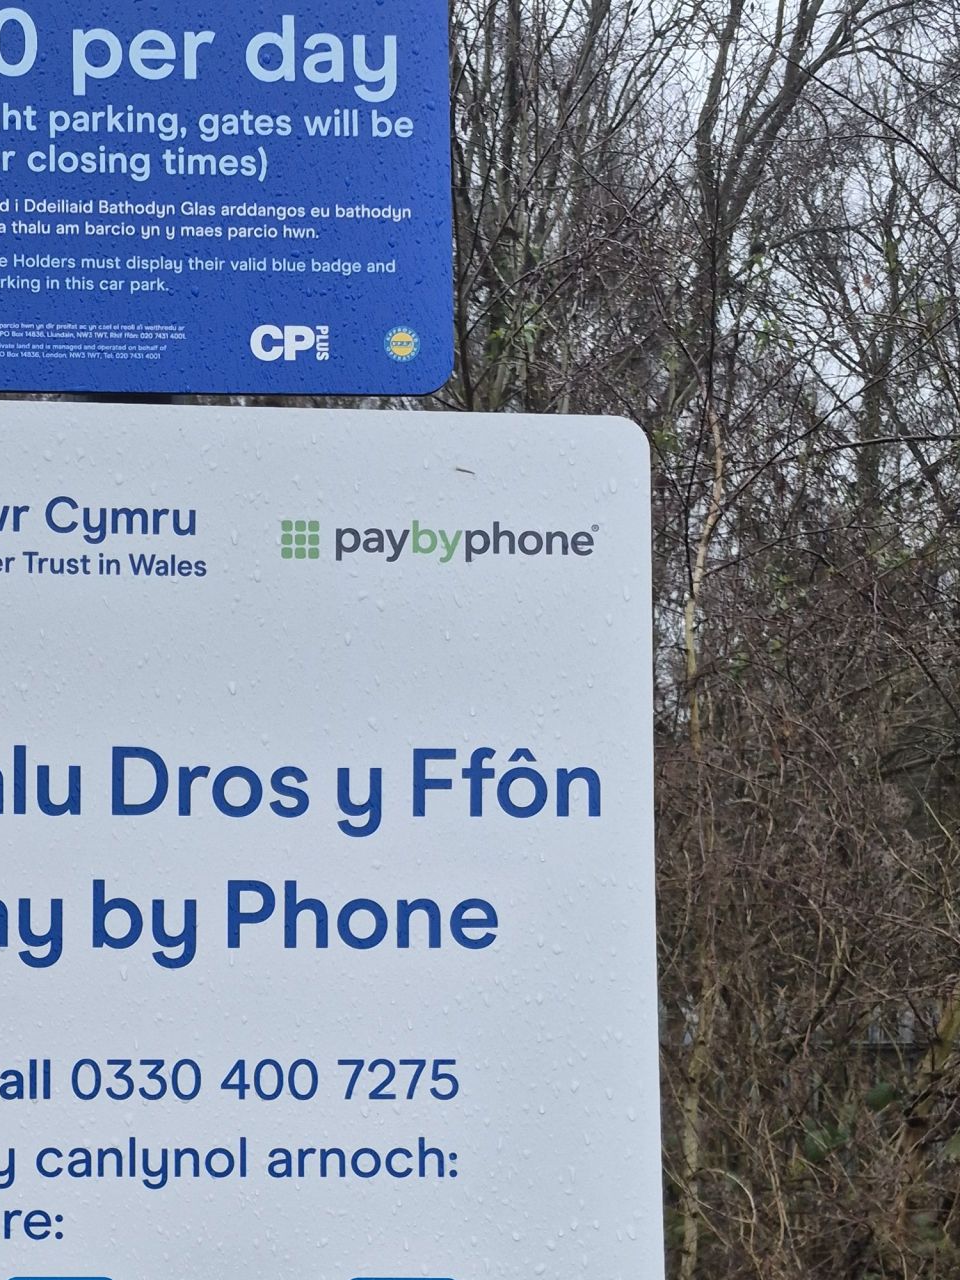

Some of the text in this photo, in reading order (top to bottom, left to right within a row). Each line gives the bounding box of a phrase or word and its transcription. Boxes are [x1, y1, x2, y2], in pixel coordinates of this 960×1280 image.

[73, 29, 215, 95] per
[246, 15, 397, 102] day
[50, 105, 186, 141] parking,
[199, 110, 291, 141] gates
[304, 109, 358, 136] will
[372, 110, 413, 137] be
[28, 144, 150, 181] closing
[163, 147, 267, 181] times)
[15, 202, 19, 211] i
[25, 199, 92, 213] Ddeiliaid
[99, 200, 175, 218] Bathodyn
[181, 202, 215, 215] Glas
[222, 203, 305, 220] arddangos
[311, 207, 329, 217] eu
[336, 205, 411, 222] bathodyn
[12, 221, 50, 233] thalu
[56, 224, 79, 234] am
[86, 222, 135, 235] barcio
[142, 226, 160, 239] yn
[166, 227, 174, 239] y
[181, 226, 222, 237] maes
[228, 225, 277, 240] parcio
[284, 225, 318, 238] hwn.
[14, 254, 75, 268] Holders
[82, 257, 120, 269] must
[126, 256, 182, 273] display
[188, 257, 225, 270] their
[231, 258, 266, 271] valid
[273, 258, 305, 271] blue
[312, 259, 361, 275] badge
[367, 260, 395, 272] and
[47, 276, 59, 289] in
[65, 277, 94, 290] this
[100, 280, 124, 290] car
[131, 278, 168, 294] park.
[250, 325, 315, 361] CP
[316, 325, 330, 361] PLUS
[46, 496, 195, 544] Cymru
[23, 552, 90, 574] Trust
[99, 553, 120, 575] in
[129, 554, 206, 576] Wales
[112, 747, 309, 818] Dros
[338, 768, 381, 837] y
[413, 747, 600, 818] Ffôn
[93, 880, 196, 968] by
[228, 880, 498, 949] Phone
[72, 1059, 201, 1100] 0330
[221, 1059, 318, 1100] 400
[338, 1059, 459, 1100] 7275
[36, 1137, 246, 1189] canlynol
[268, 1137, 457, 1178] arnoch:
